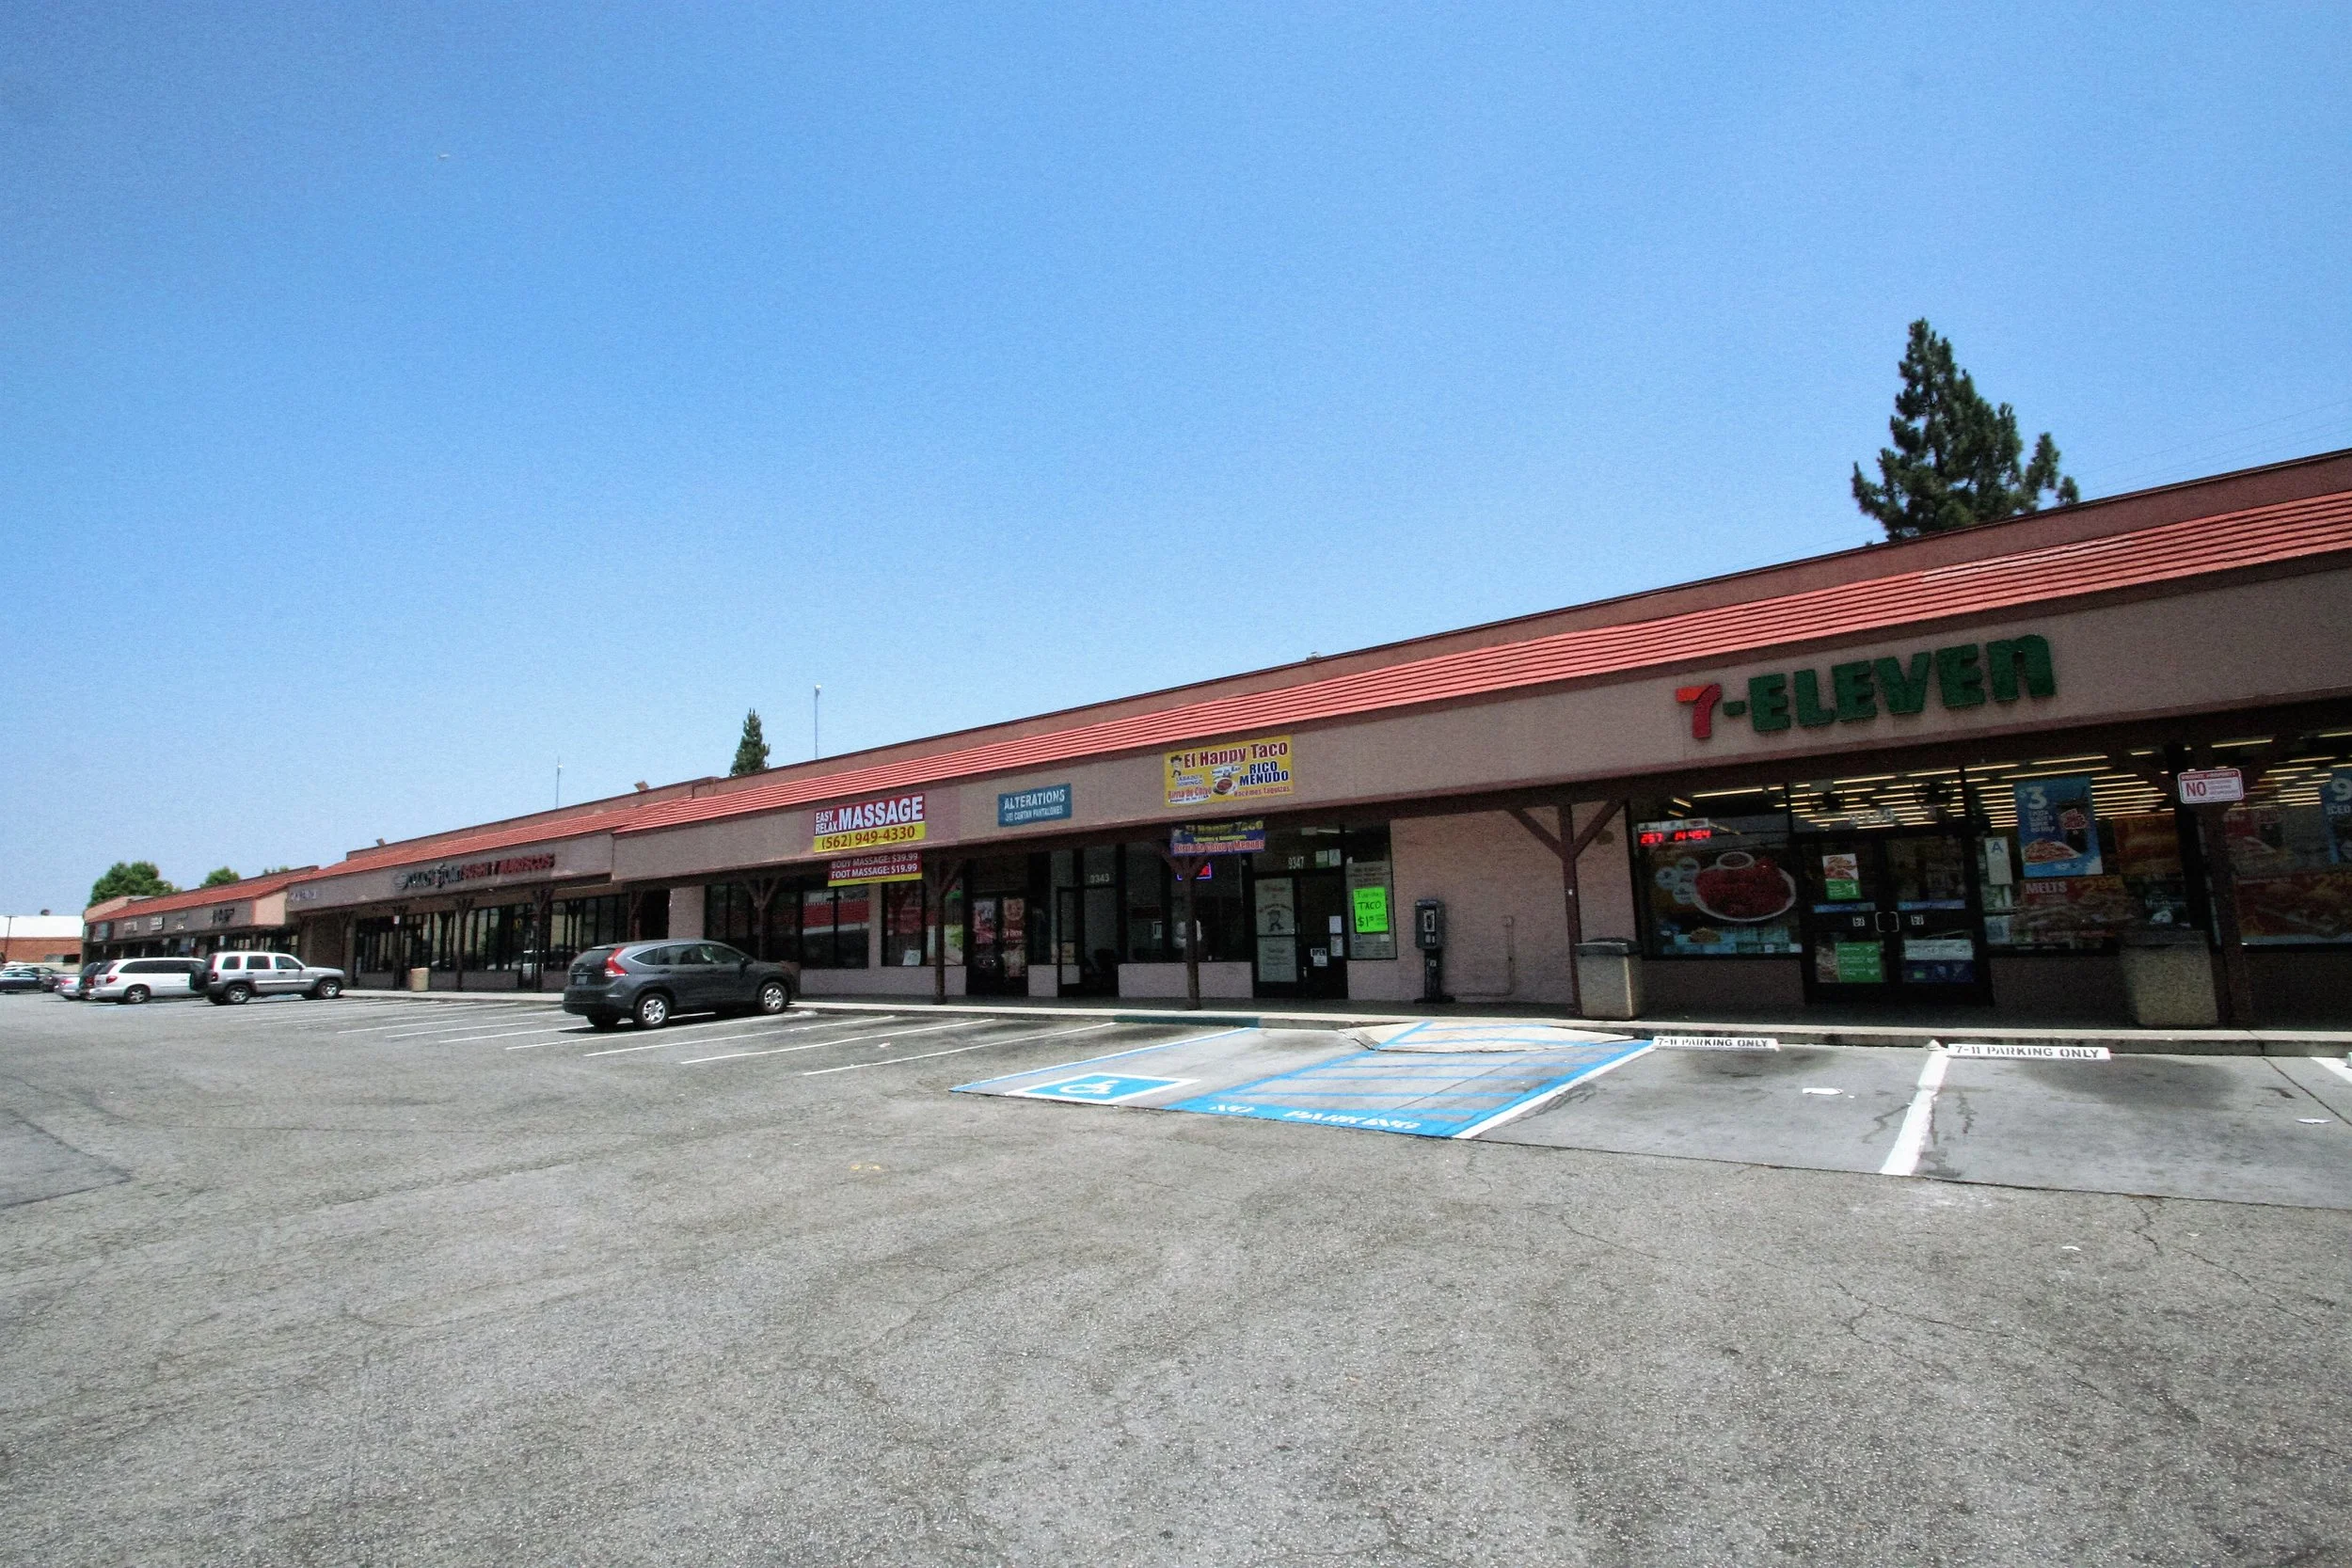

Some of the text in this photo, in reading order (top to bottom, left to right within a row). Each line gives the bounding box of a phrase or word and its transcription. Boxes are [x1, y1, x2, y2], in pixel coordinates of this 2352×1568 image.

[1184, 741, 1288, 768] El Happy Taco
[1248, 761, 1278, 774] RICO
[1239, 770, 1289, 786] MENUDO
[2185, 781, 2207, 797] NO
[1004, 789, 1065, 811] ALTERATIONS
[838, 795, 924, 832] MASSAGE
[2326, 803, 2351, 815] ICED
[815, 810, 834, 824] EASY
[815, 820, 838, 835] RELAX
[821, 825, 915, 850] (562) 949-4330
[1991, 841, 2003, 853] A
[832, 852, 918, 869] BODY MASSAGE: $39.99
[1287, 856, 1305, 869] 9347
[832, 863, 918, 879] FOOT MASSAGE: $19.99
[2025, 880, 2068, 895] MELTS
[1358, 901, 1382, 911] TACO
[1658, 1037, 1677, 1046] 7-11
[1681, 1037, 1732, 1047] PARKING
[1956, 1045, 2100, 1058] 7-11 PARKING ONLY
[1282, 1110, 1422, 1130] PARKING
